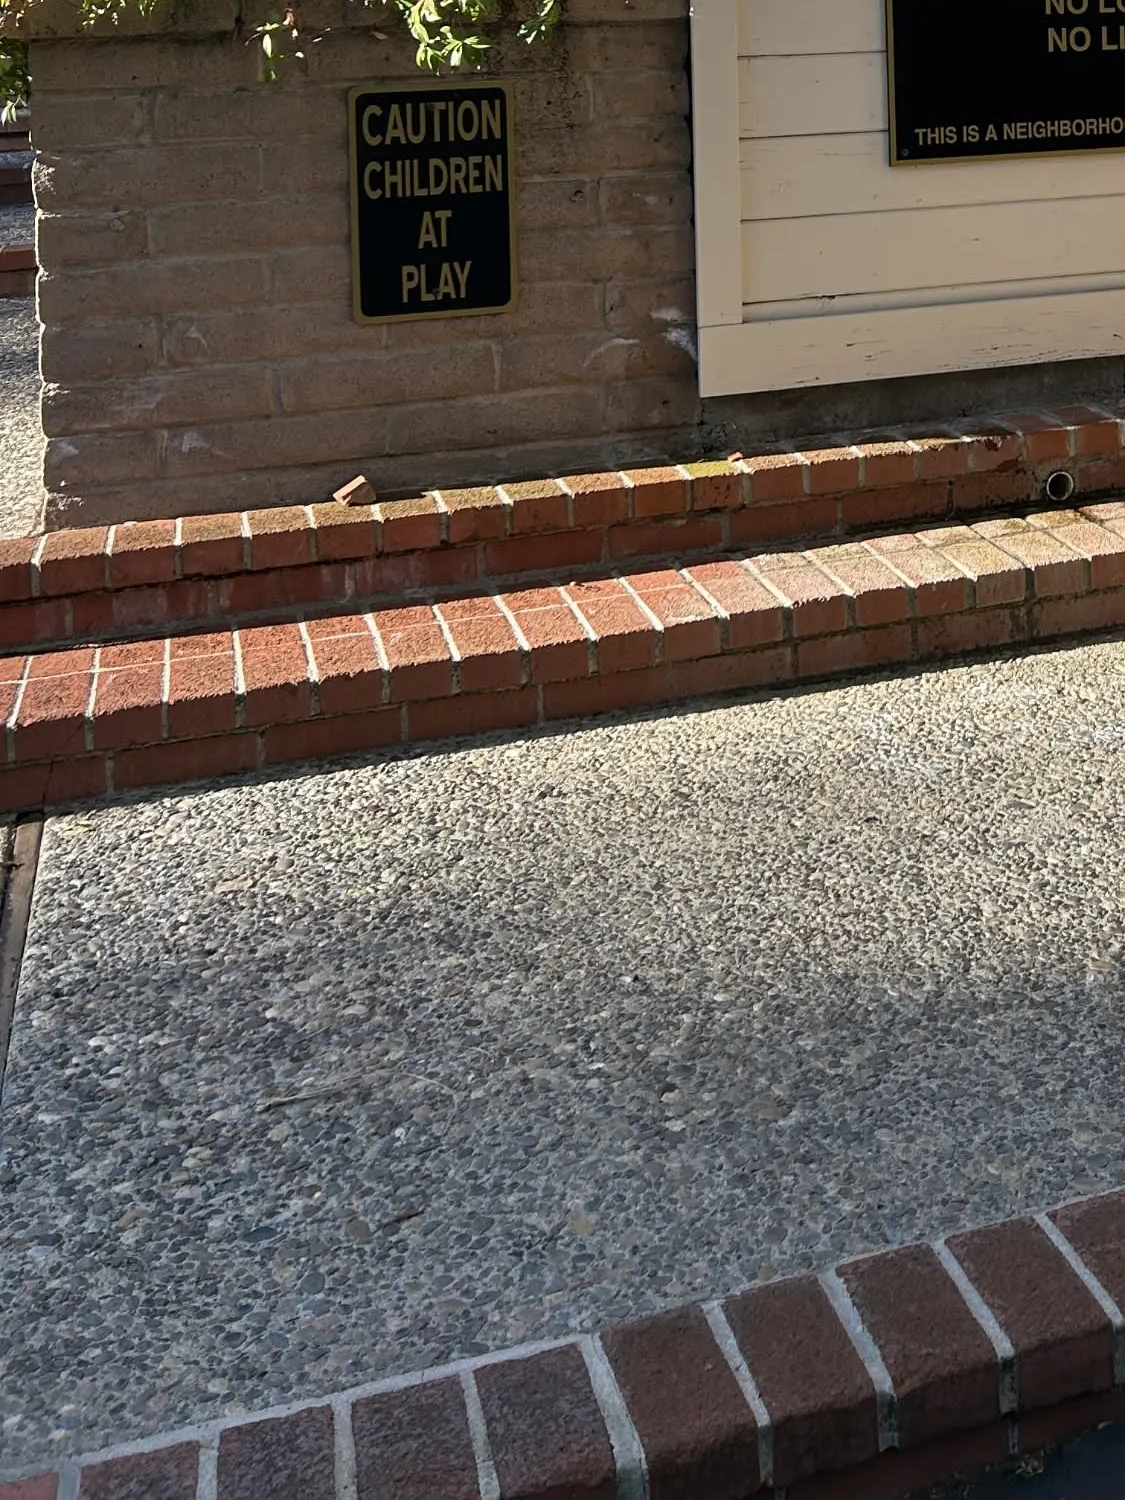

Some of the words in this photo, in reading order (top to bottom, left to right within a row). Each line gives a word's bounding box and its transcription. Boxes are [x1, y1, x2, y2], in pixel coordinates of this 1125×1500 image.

[1047, 26, 1091, 53] NO
[362, 99, 502, 147] CAUTION
[914, 125, 958, 146] THIS
[962, 124, 980, 143] IS
[984, 123, 998, 141] A
[363, 154, 503, 200] CHILDREN
[417, 209, 453, 250] AT
[401, 260, 472, 303] PLAY
